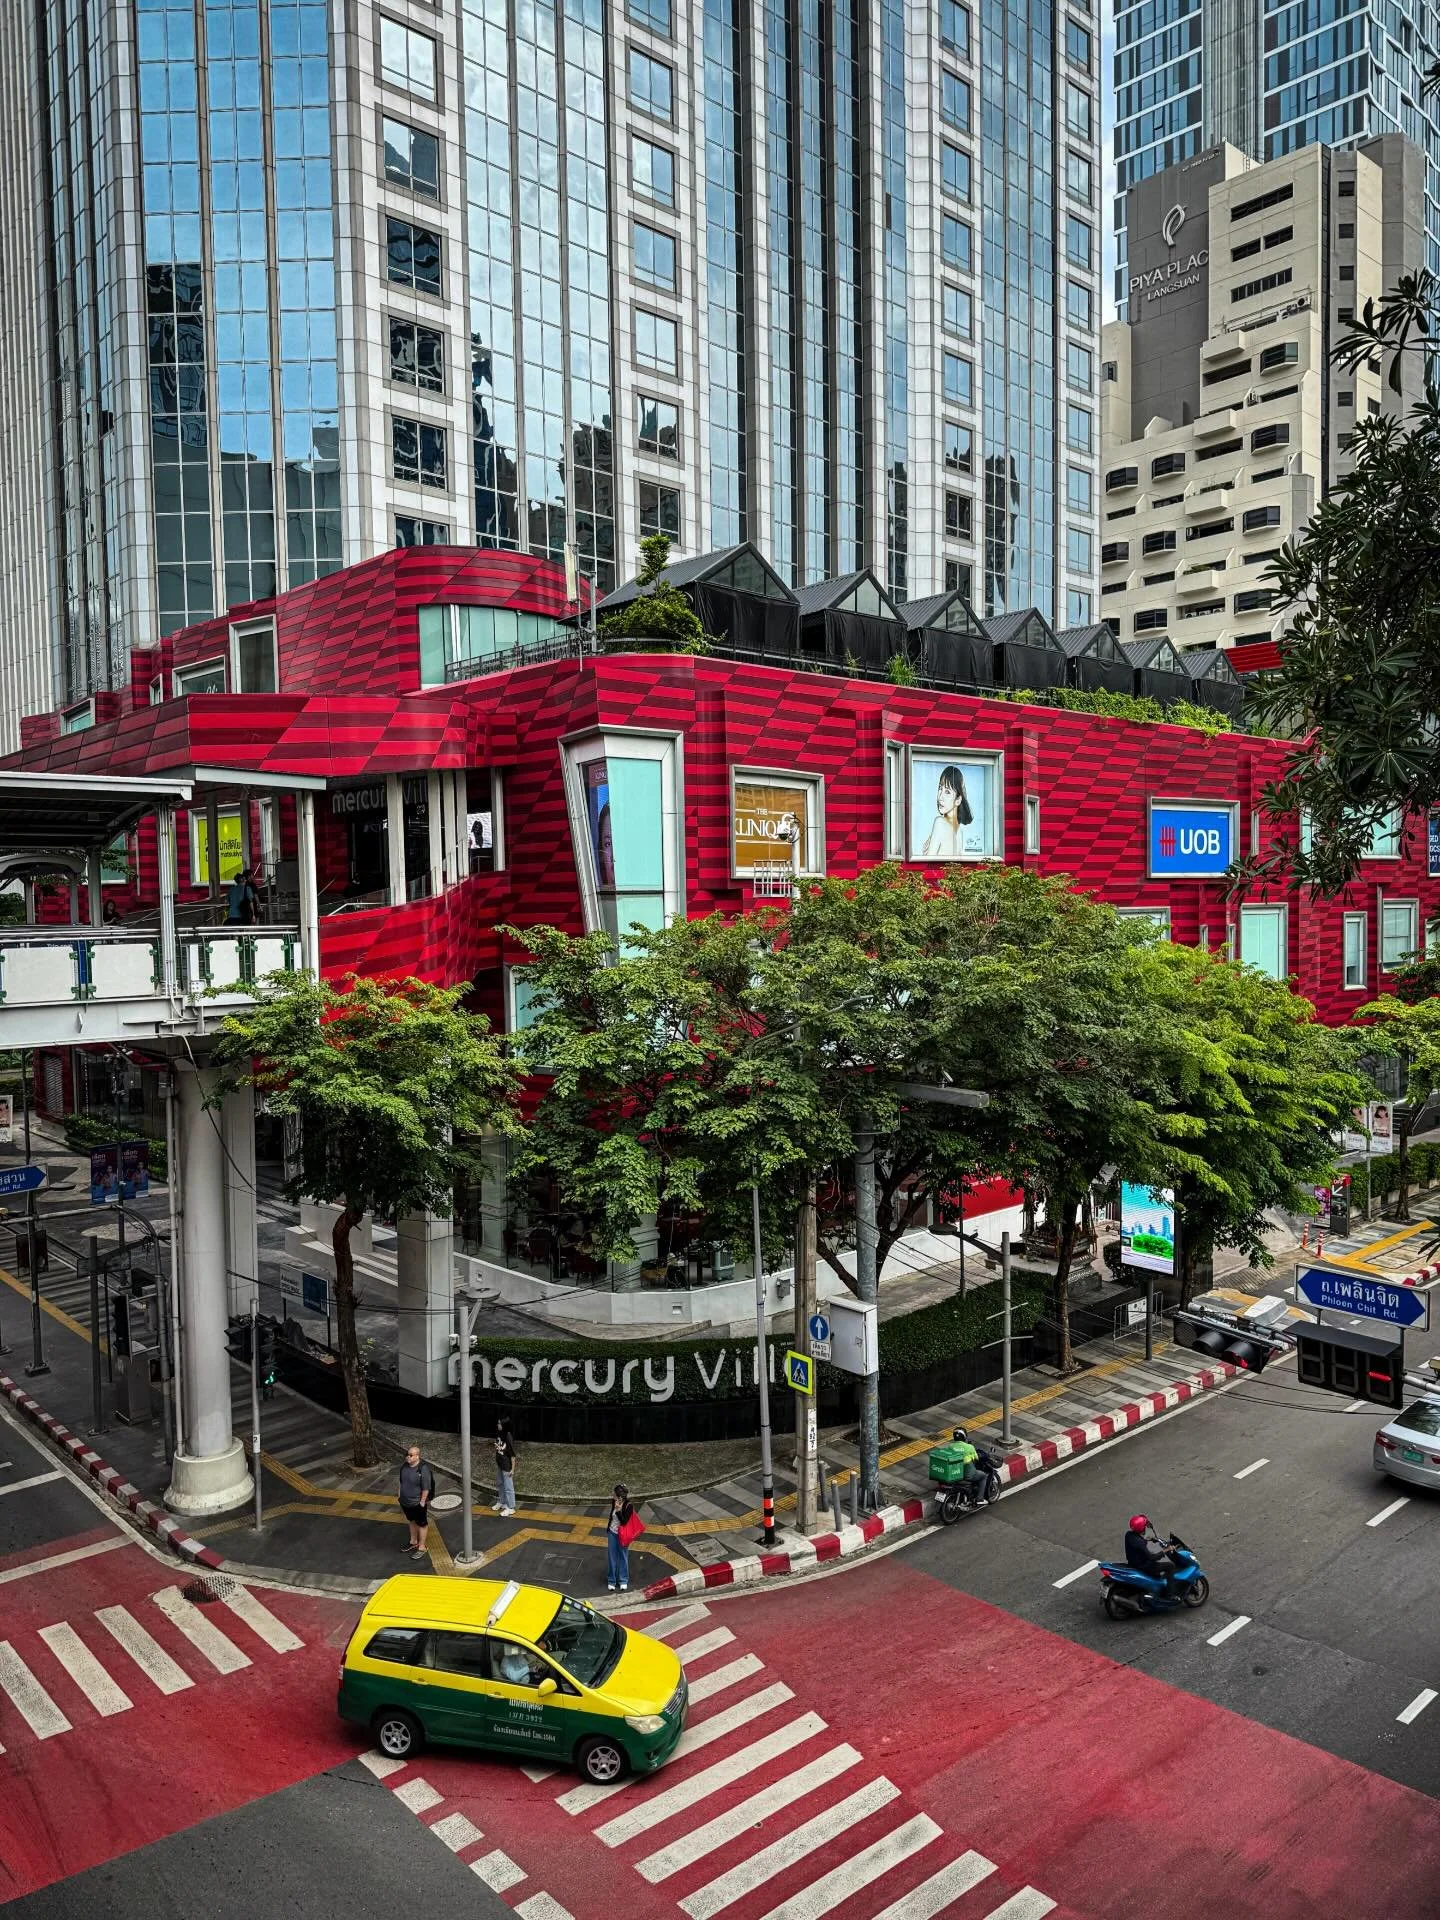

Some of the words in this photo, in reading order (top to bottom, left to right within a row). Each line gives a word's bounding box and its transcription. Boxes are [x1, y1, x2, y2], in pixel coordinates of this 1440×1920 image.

[1129, 268, 1163, 294] PIYA
[1167, 249, 1209, 278] PLAC
[1147, 273, 1200, 301] LANGSUAN
[332, 786, 386, 814] mercur
[403, 780, 428, 805] Vill
[1180, 828, 1220, 855] UOB
[1321, 1280, 1400, 1308] ถ.เพลินจิต
[1321, 1295, 1352, 1309] Phloen
[1357, 1302, 1376, 1315] Chit
[1383, 1308, 1399, 1319] Rd.
[448, 1351, 675, 1403] mercury
[693, 1343, 790, 1390] Vill
